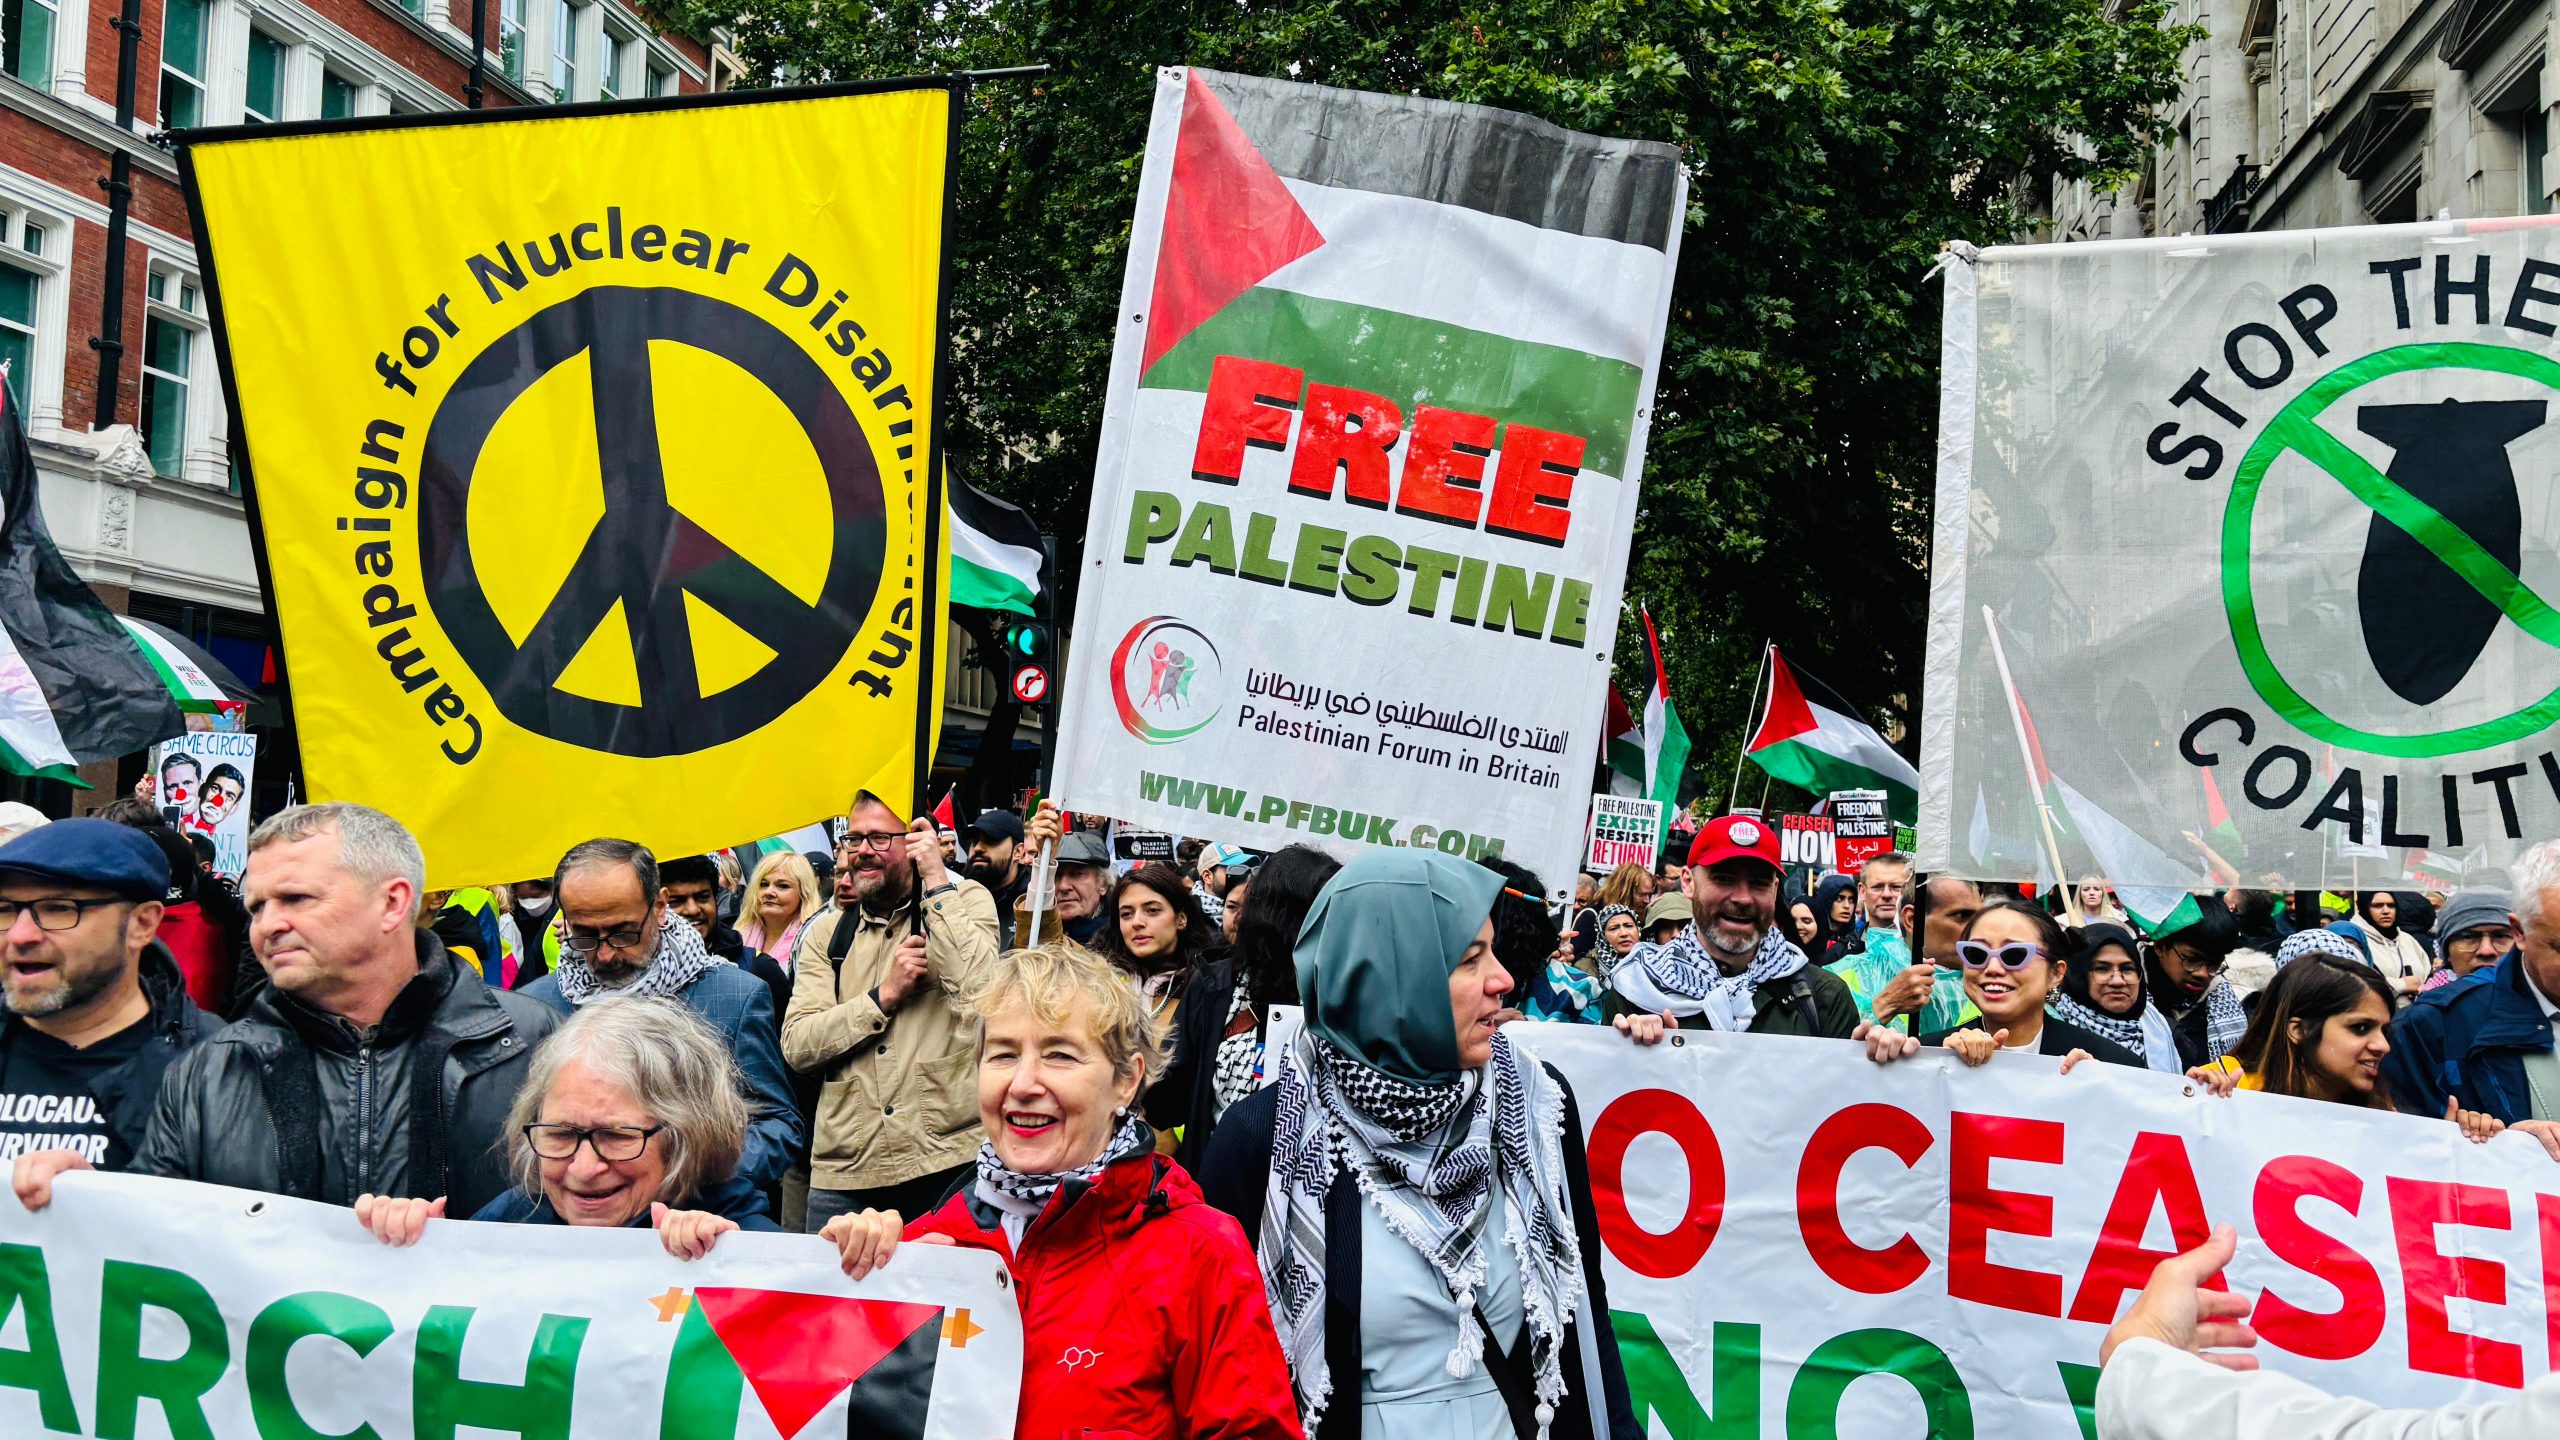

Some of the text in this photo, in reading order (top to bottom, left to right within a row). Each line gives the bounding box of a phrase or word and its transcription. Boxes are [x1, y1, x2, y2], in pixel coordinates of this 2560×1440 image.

[465, 206, 751, 306] Nuclear
[375, 293, 461, 397] for
[2146, 253, 2560, 481] STOP THE
[1191, 354, 1587, 548] FREE
[337, 417, 483, 766] Campaign
[1123, 490, 1594, 648] PALESTINE
[206, 735, 254, 757] CIRCUS
[1238, 705, 1560, 789] Palestinian Forum in Britain
[1246, 668, 1569, 755] المنتدى الفلسطيني في بريطانيا
[1139, 770, 1506, 862] WWW.PFBUK.COM
[1594, 828, 1654, 845] RESIST!
[1596, 814, 1656, 833] EXIST!
[1598, 798, 1656, 818] FREE PALESTINE
[1783, 814, 1834, 832] CEASEFI
[1837, 802, 1883, 816] FREEDOM
[1837, 821, 1888, 836] PALESTINE
[1592, 839, 1653, 869] RETURN!
[1795, 1102, 2560, 1390] CEASE
